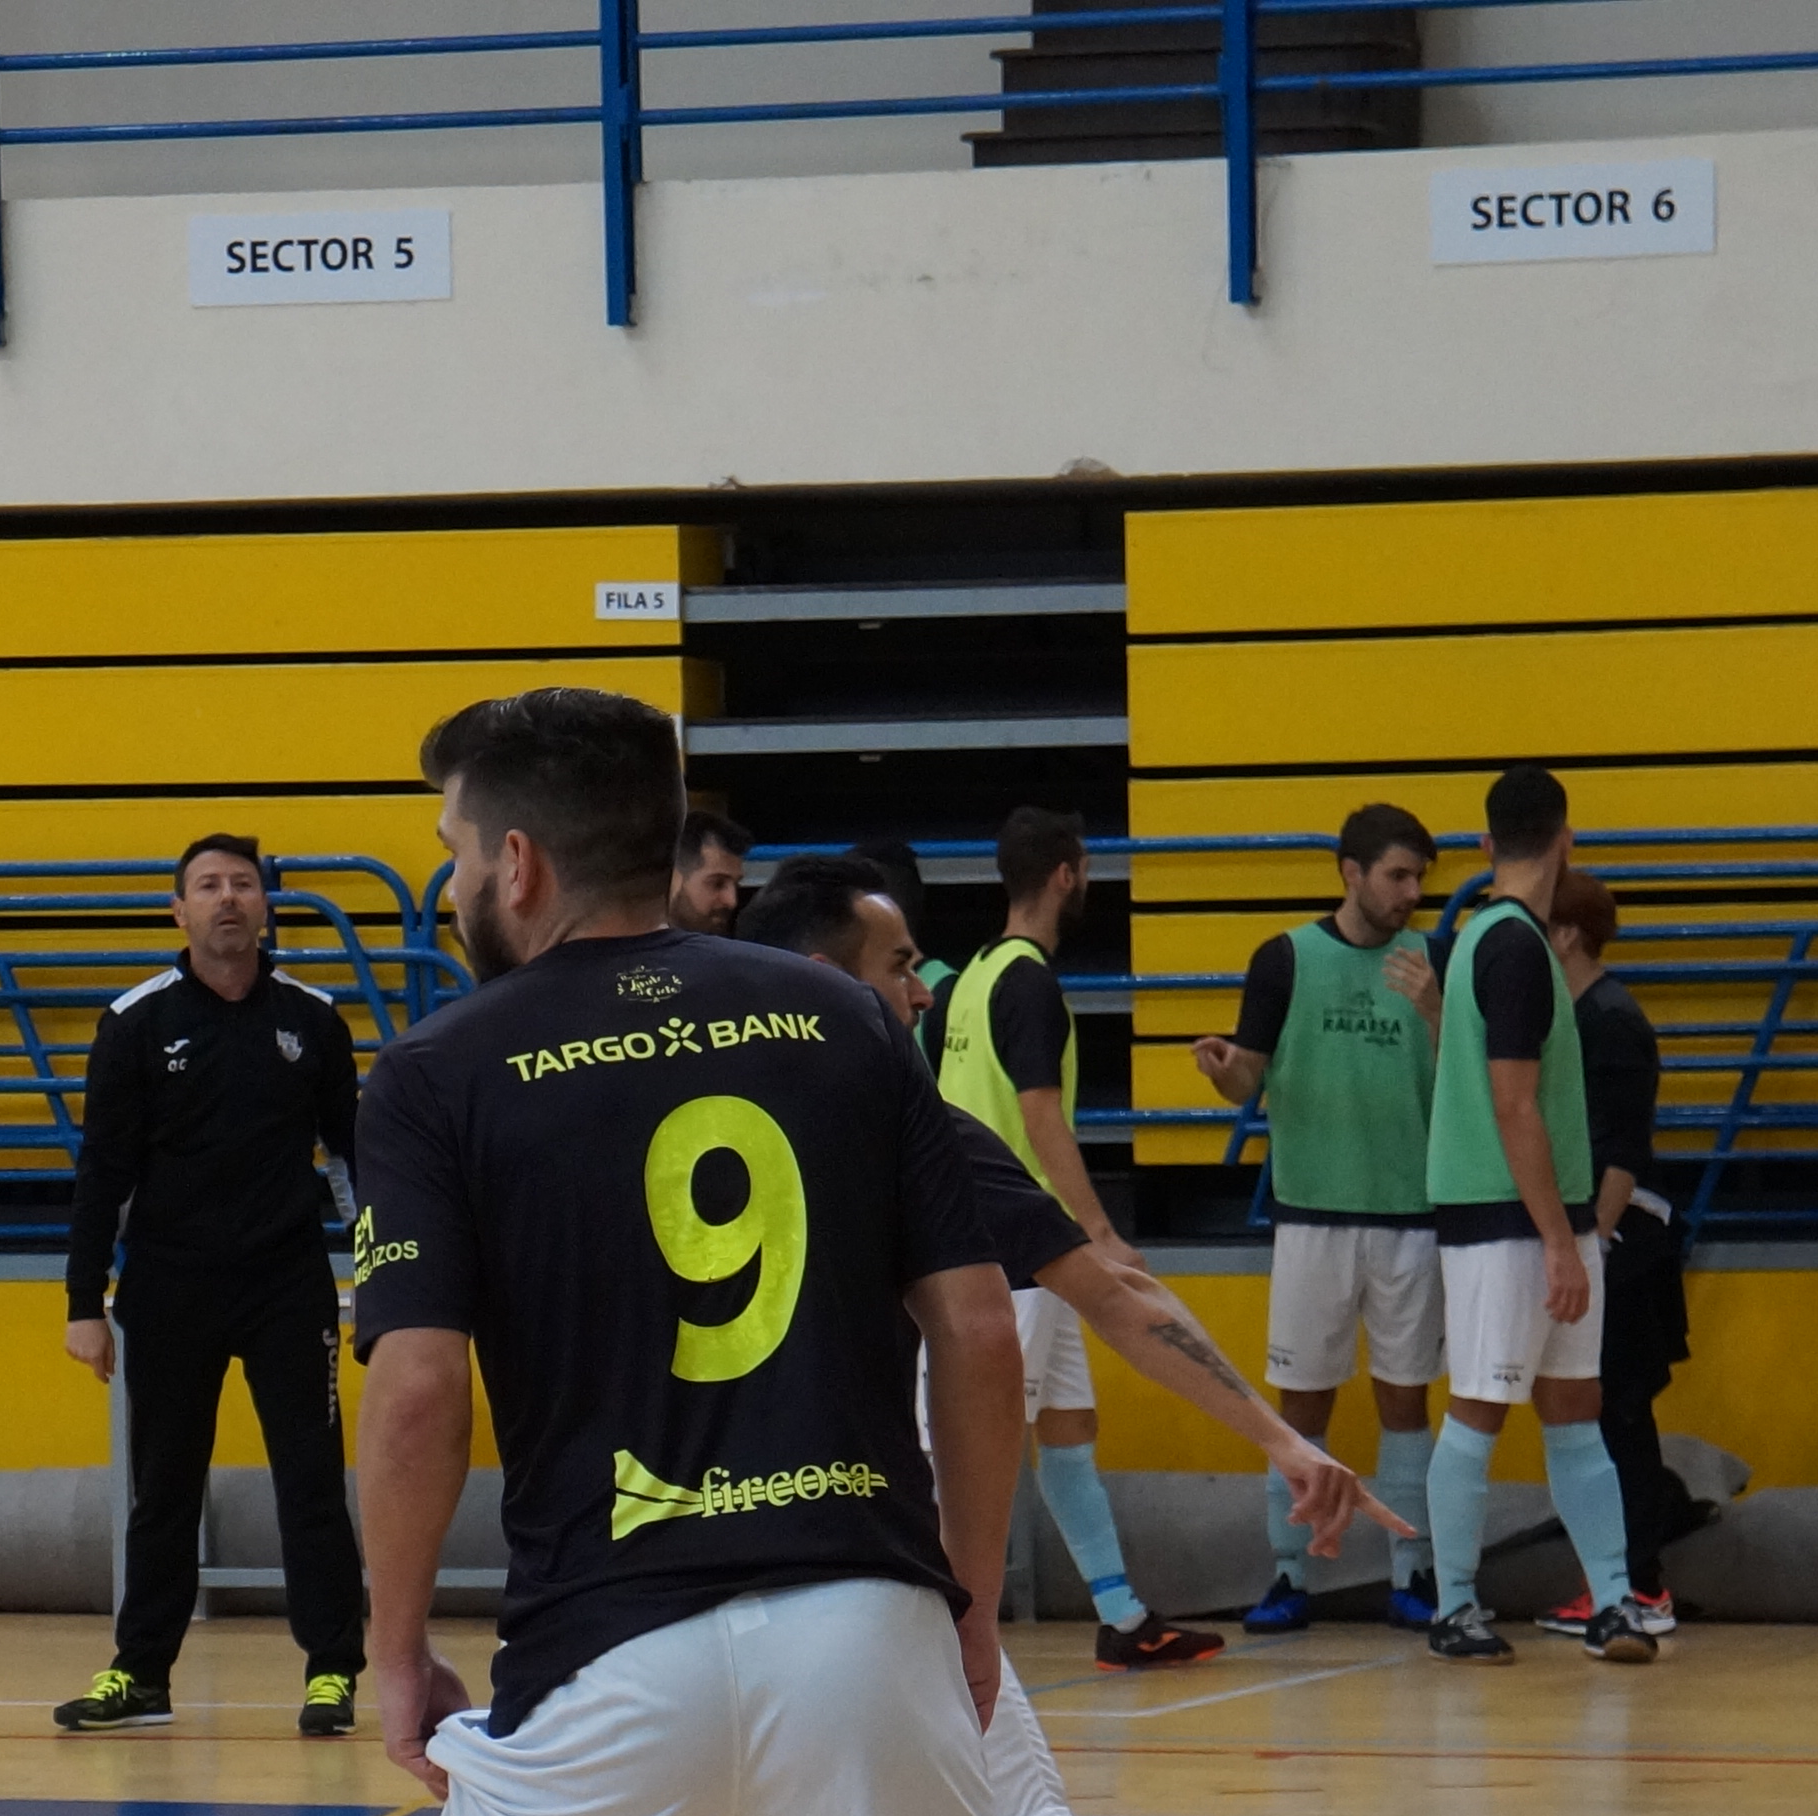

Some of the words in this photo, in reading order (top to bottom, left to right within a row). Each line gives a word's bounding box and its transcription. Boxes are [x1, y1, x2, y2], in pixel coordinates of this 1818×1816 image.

[1471, 190, 1632, 230] SECTOR
[1652, 188, 1676, 222] 6
[226, 237, 374, 274] SECTOR
[394, 236, 415, 269] 5
[605, 591, 648, 609] FILA
[653, 592, 665, 609] 5
[644, 1095, 807, 1382] 9
[701, 1461, 881, 1518] fircosa
